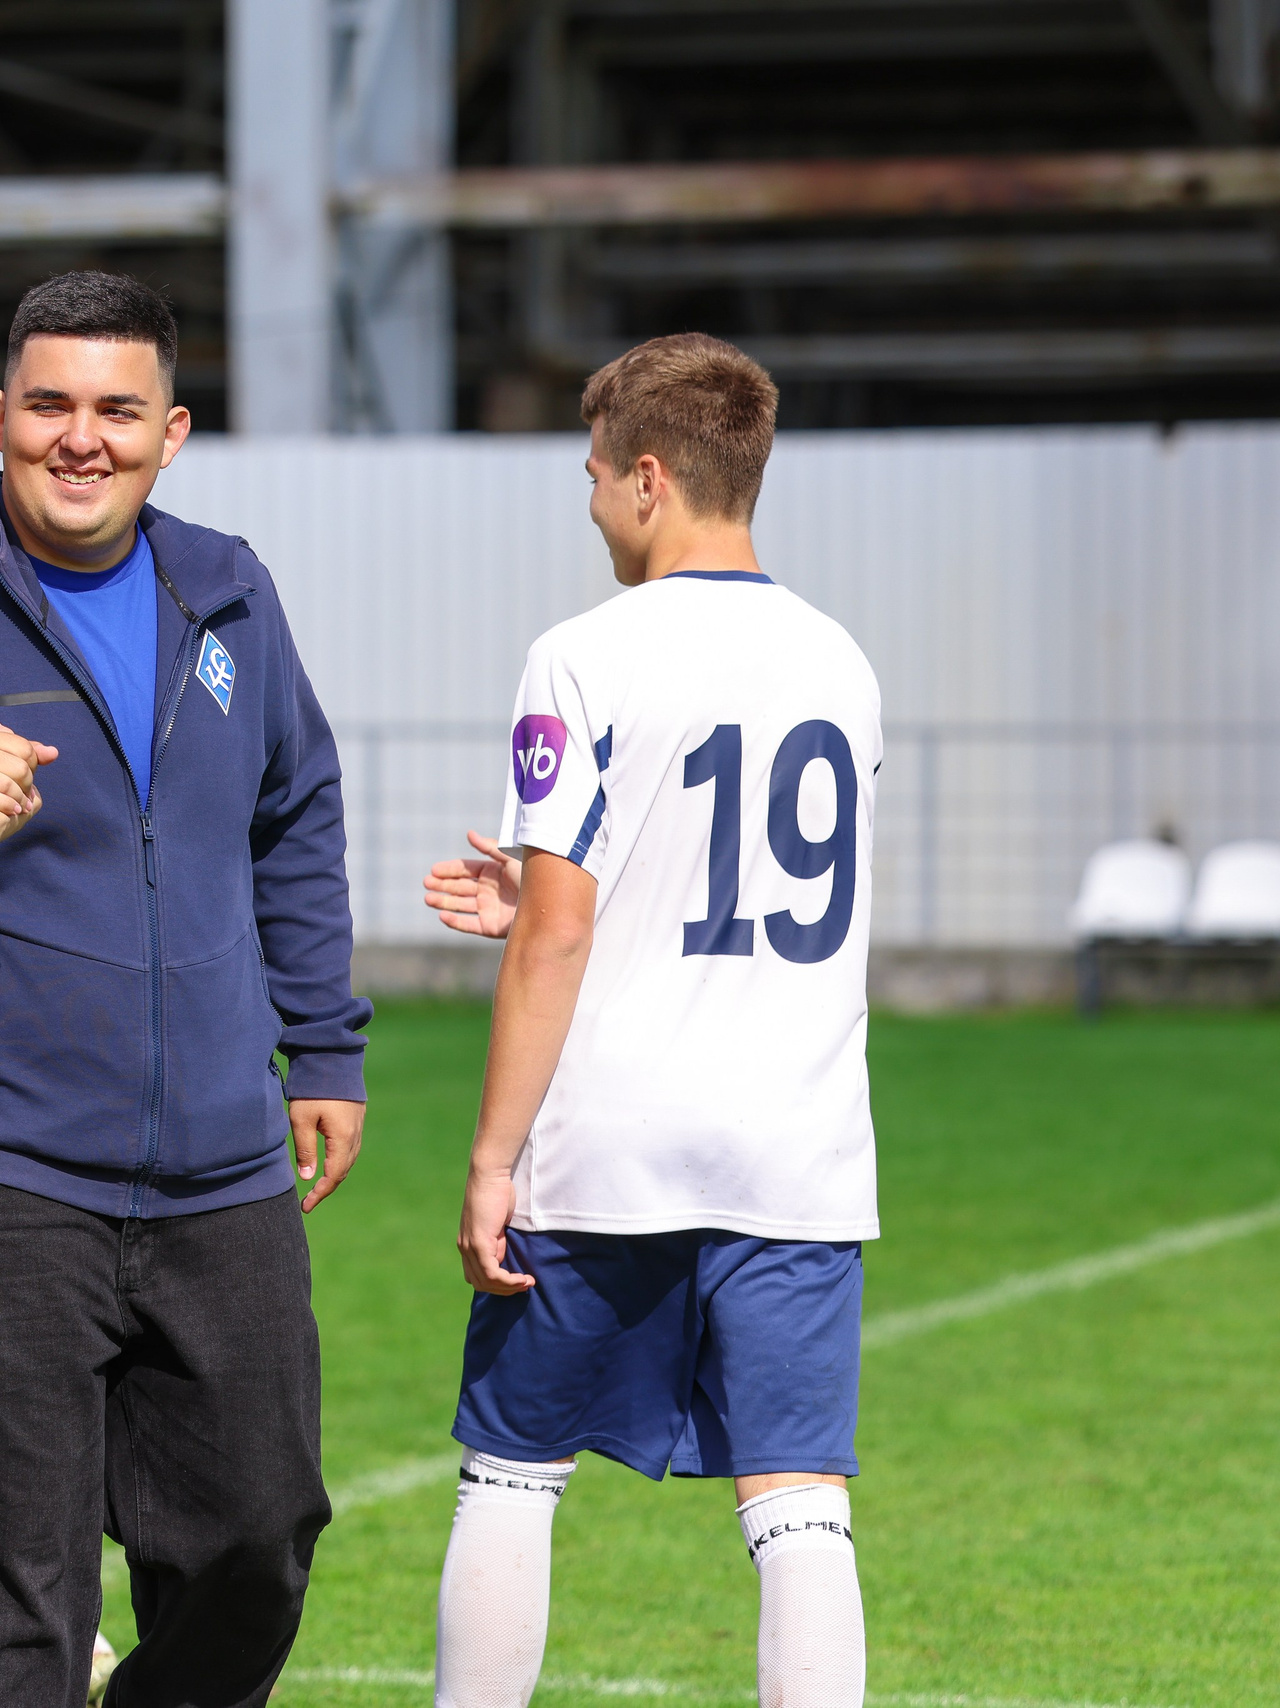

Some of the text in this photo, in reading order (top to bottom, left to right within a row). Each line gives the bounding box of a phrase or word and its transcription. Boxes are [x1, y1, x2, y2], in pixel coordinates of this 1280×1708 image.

[517, 733, 557, 780] vb
[681, 719, 857, 964] 19
[486, 1477, 563, 1496] KELME
[754, 1521, 841, 1550] KELME
